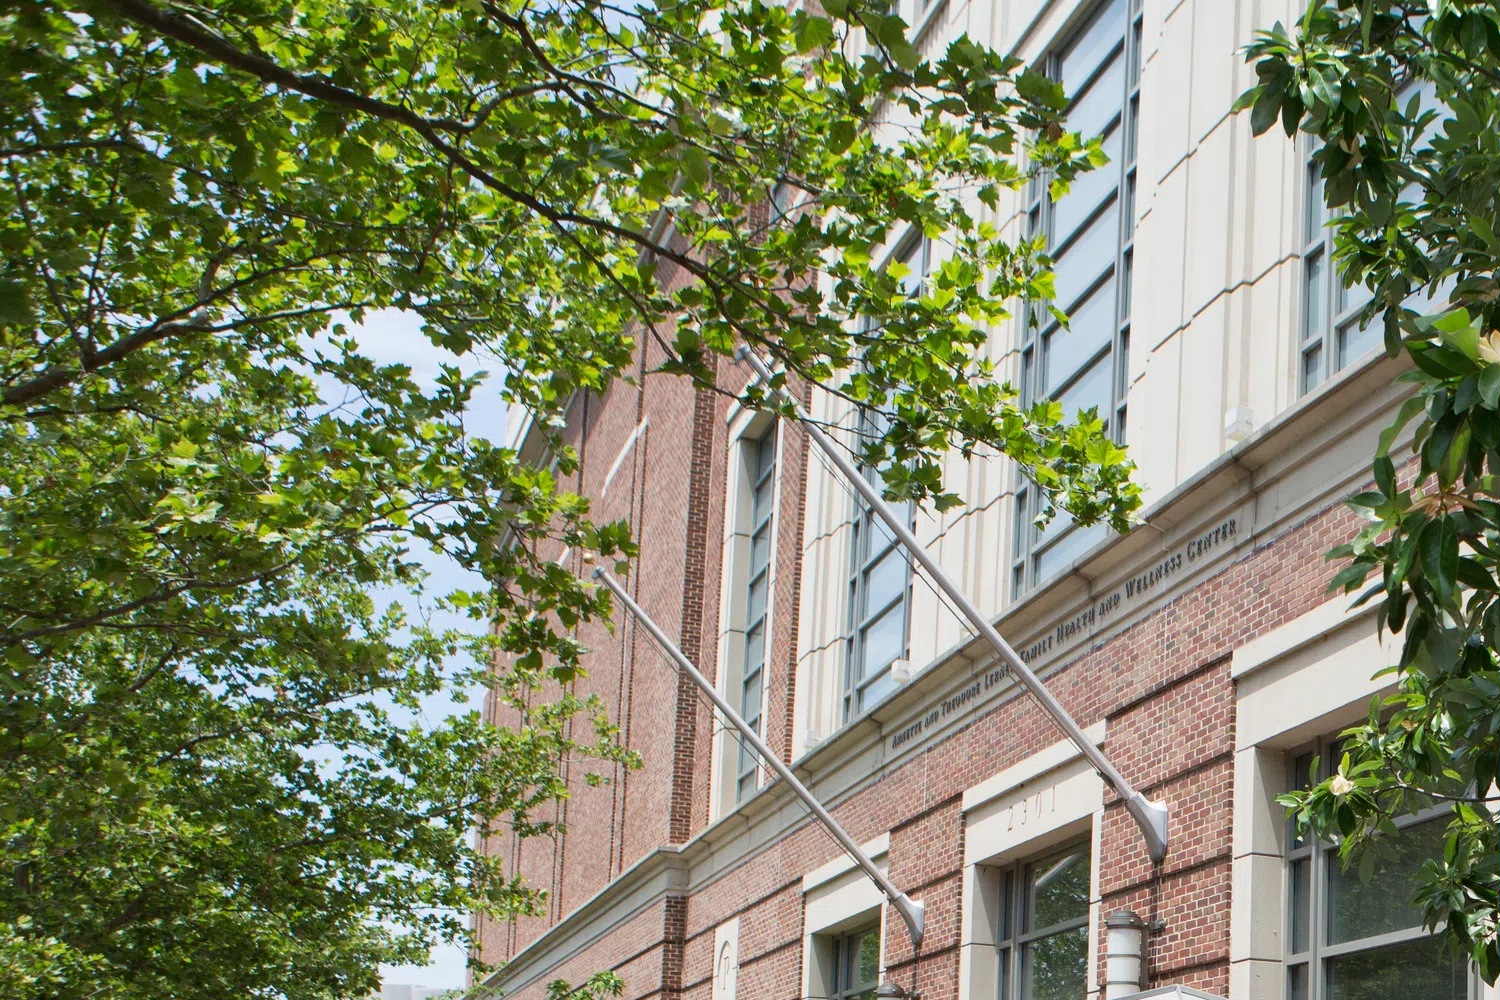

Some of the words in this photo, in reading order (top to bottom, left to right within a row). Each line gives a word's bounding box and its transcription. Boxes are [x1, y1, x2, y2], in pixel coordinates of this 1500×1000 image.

[891, 719, 923, 749] ANNETTE
[924, 710, 939, 728] AND
[940, 681, 981, 717] THEODORE
[984, 664, 1014, 691] LERNE
[1019, 636, 1054, 664] FAMILY
[1056, 606, 1095, 643] HEALTH
[1098, 593, 1121, 617] AND
[1125, 553, 1182, 599] WELLNESS
[1186, 519, 1237, 561] CENTER
